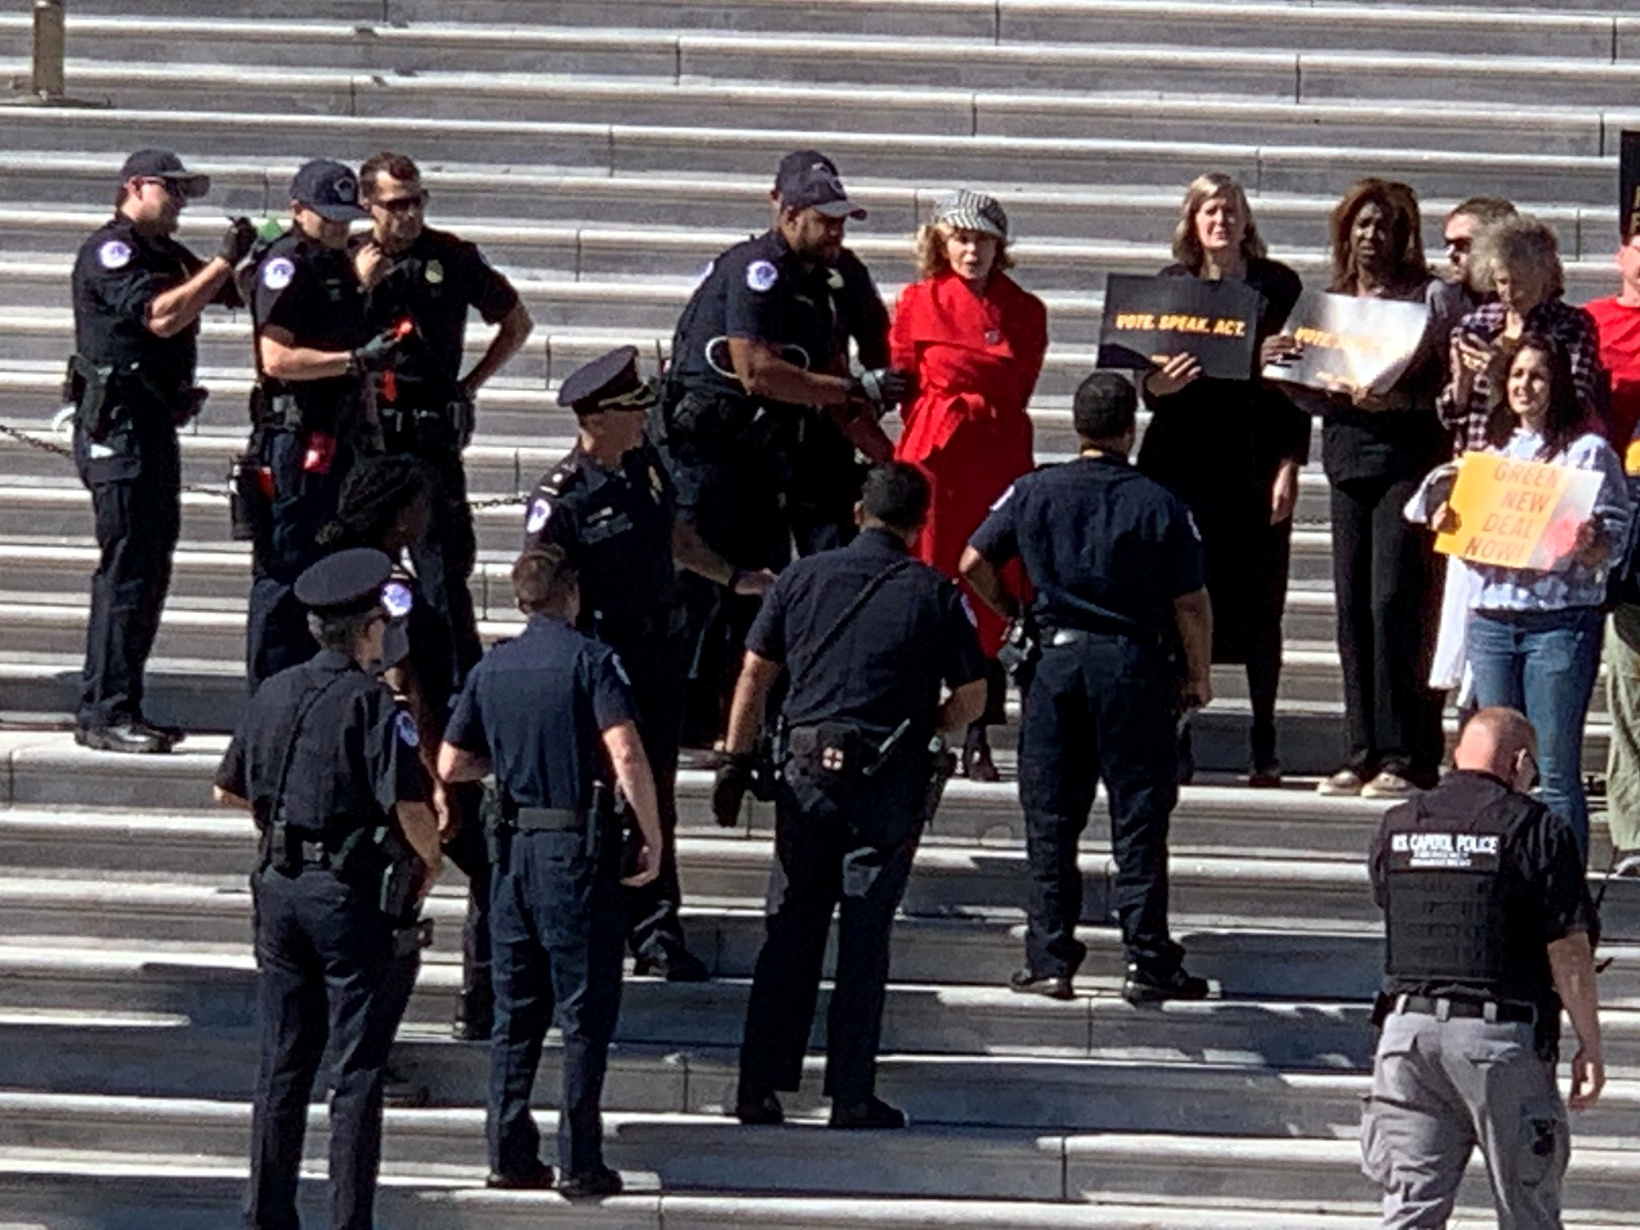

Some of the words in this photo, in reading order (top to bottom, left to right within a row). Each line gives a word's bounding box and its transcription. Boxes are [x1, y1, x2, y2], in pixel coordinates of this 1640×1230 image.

[1493, 461, 1559, 488] GREEN
[1501, 490, 1550, 513] NEW
[1482, 513, 1534, 538] DEAL
[1465, 537, 1523, 561] NOW!
[1457, 834, 1499, 853] POLICE
